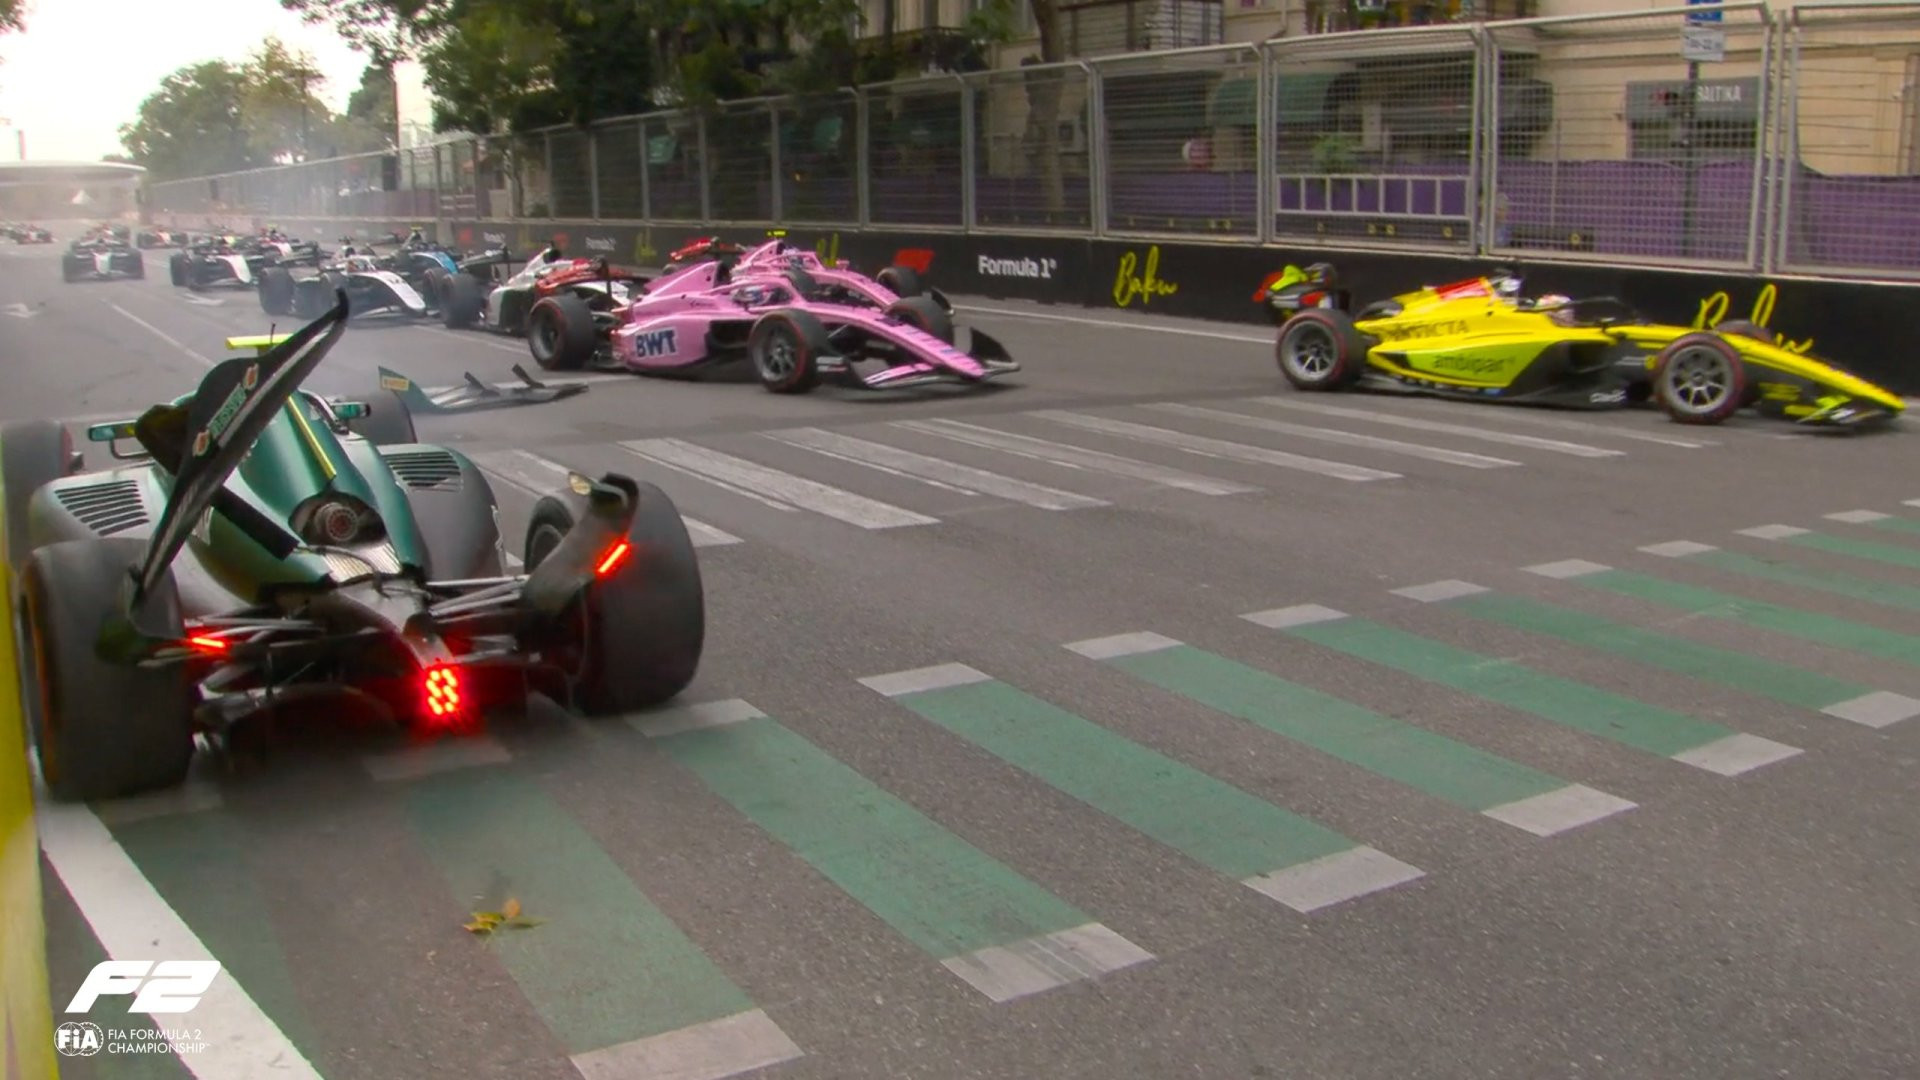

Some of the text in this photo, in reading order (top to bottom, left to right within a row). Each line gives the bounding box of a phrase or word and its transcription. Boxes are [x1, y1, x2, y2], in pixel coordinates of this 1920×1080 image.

[978, 255, 1039, 278] Formula
[1113, 245, 1178, 307] Baku
[636, 329, 676, 358] BWT
